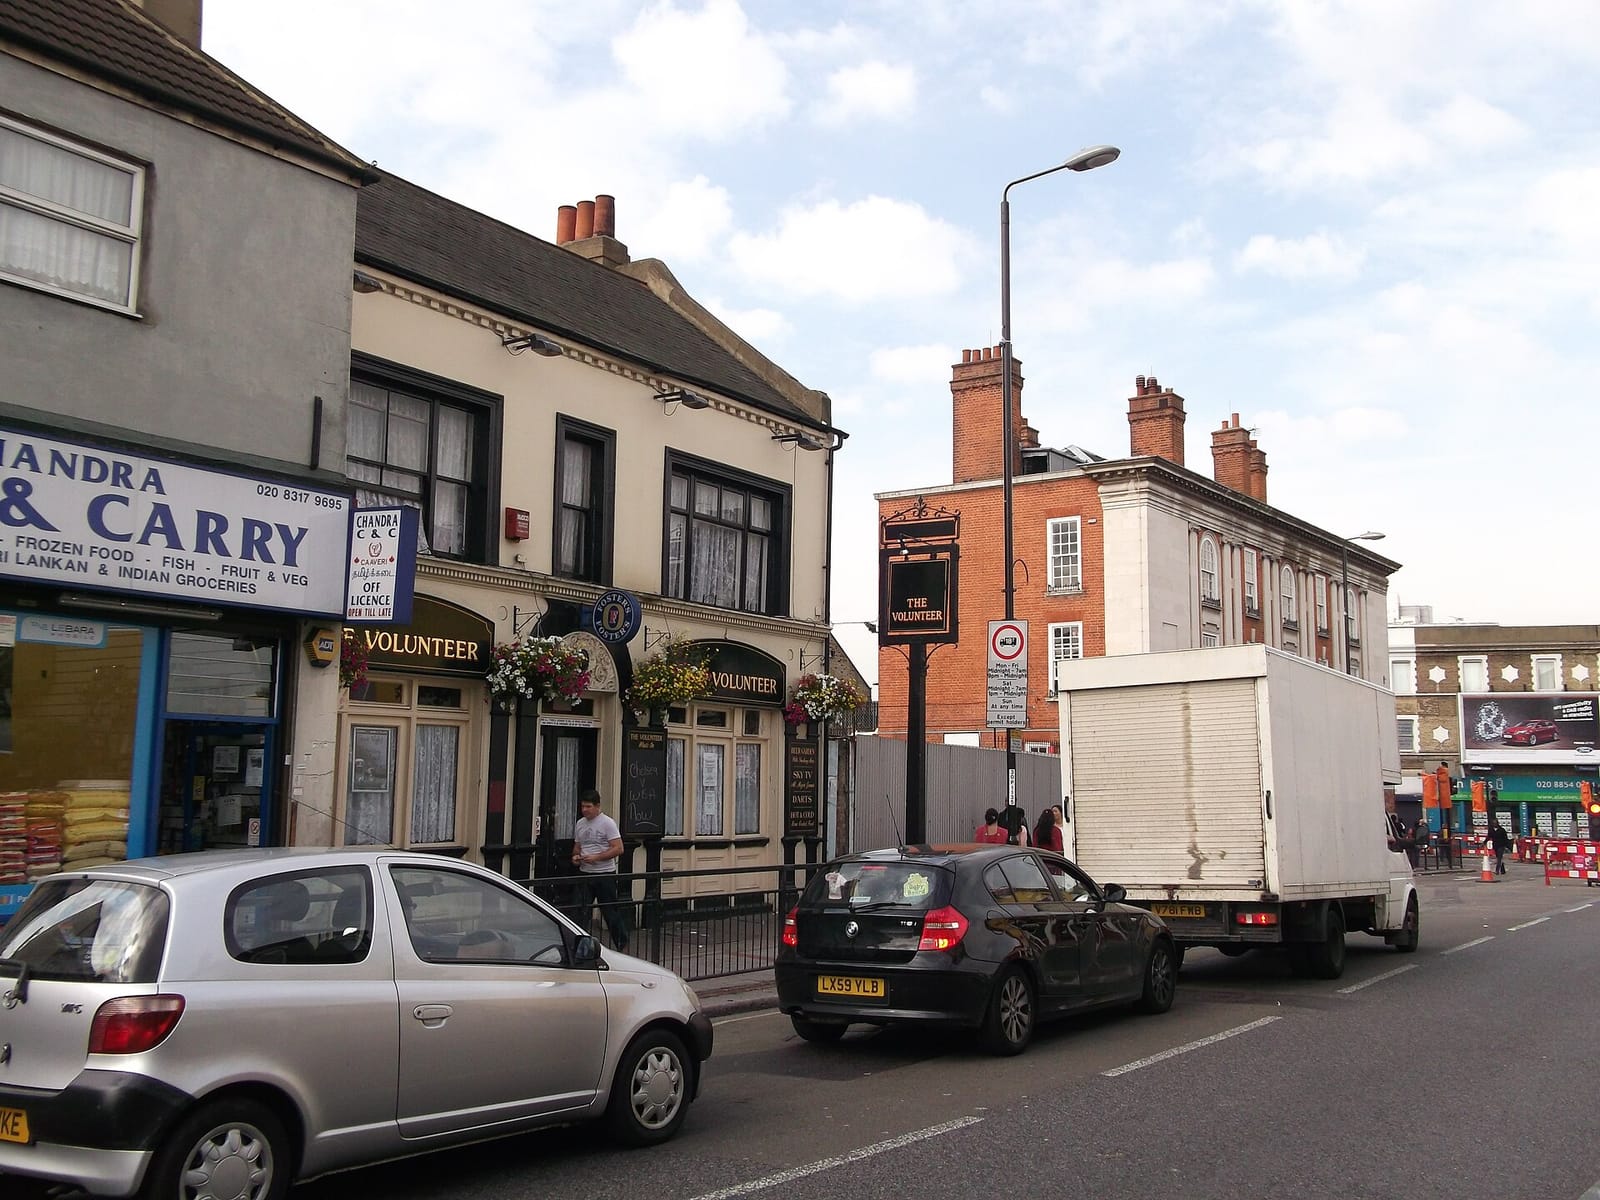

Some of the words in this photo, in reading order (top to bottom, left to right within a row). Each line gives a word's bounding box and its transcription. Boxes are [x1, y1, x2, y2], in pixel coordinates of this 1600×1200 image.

[256, 484, 278, 498] 020
[283, 490, 310, 503] 8317
[314, 496, 342, 510] 9695
[0, 477, 61, 532] &
[87, 494, 308, 567] CARRY
[356, 514, 398, 528] CHANDRA
[357, 529, 365, 539] C
[371, 529, 380, 538] &
[388, 528, 396, 537] C
[16, 536, 83, 556] FROZEN
[89, 546, 134, 562] FOOD
[162, 556, 195, 571] FISH
[221, 565, 260, 580] FRUIT
[267, 571, 276, 582] &
[282, 573, 308, 586] VEG
[16, 553, 88, 573] LANKAN
[98, 564, 108, 575] &
[119, 566, 170, 583] INDIAN
[176, 574, 257, 594] GROCERIES
[363, 582, 380, 593] OFF
[351, 595, 390, 606] LICENCE
[906, 598, 928, 608] THE
[348, 608, 361, 617] OPEN
[365, 607, 376, 617] TILL
[379, 607, 391, 617] LATE
[892, 610, 943, 621] VOLUNTEER
[51, 624, 95, 634] LEBARA
[364, 630, 479, 661] VOLUNTEER
[712, 671, 777, 694] VOLUNTEER
[822, 981, 851, 991] LX59
[856, 982, 879, 993] YLB
[0, 1111, 22, 1136] KE
